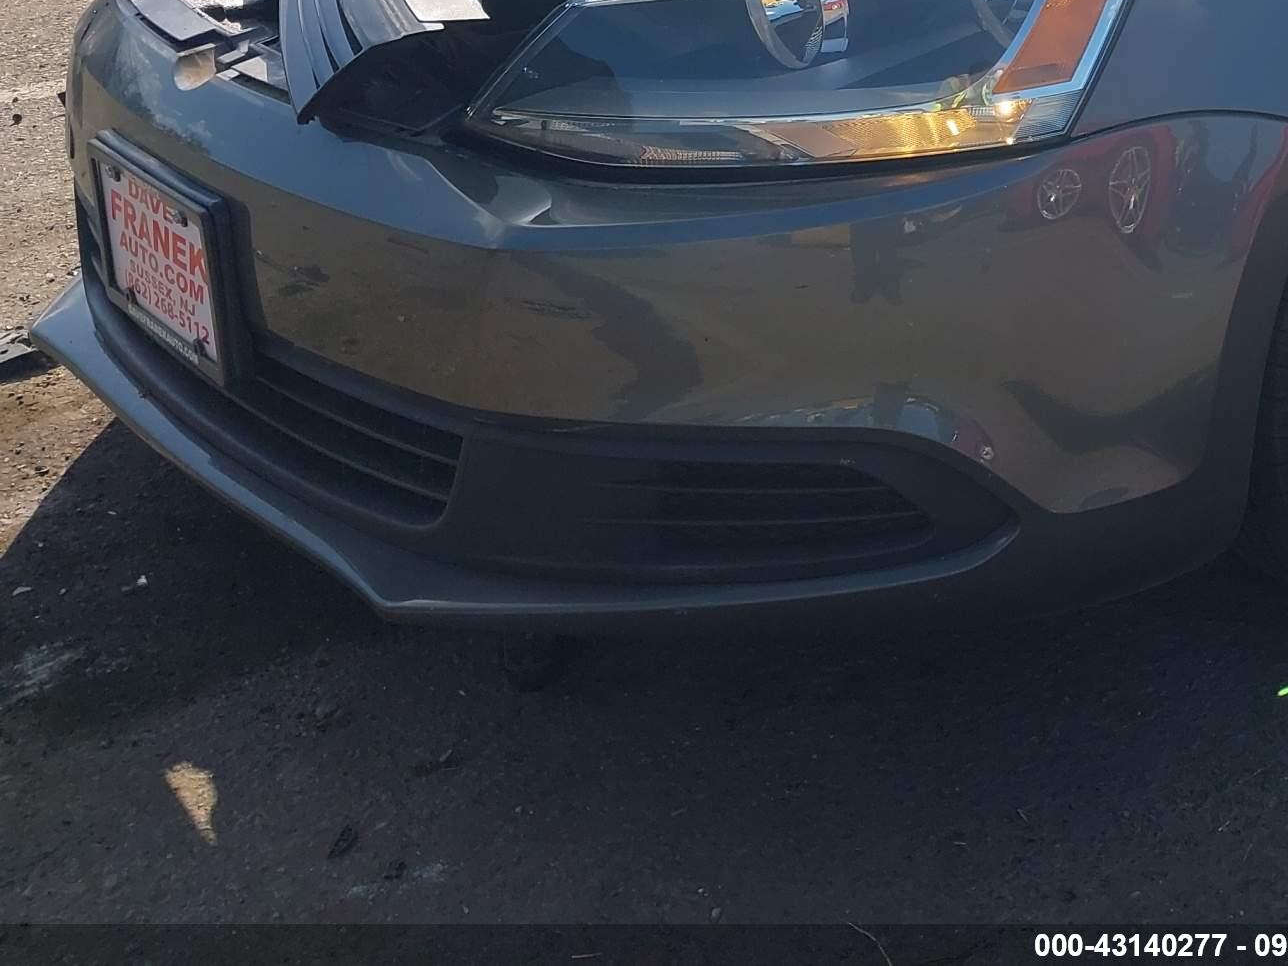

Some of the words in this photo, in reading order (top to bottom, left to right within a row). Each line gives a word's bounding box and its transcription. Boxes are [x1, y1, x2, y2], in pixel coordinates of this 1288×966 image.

[111, 188, 208, 284] FRANEK
[119, 233, 204, 305] AUTO.COM
[153, 290, 210, 346] 268-5112
